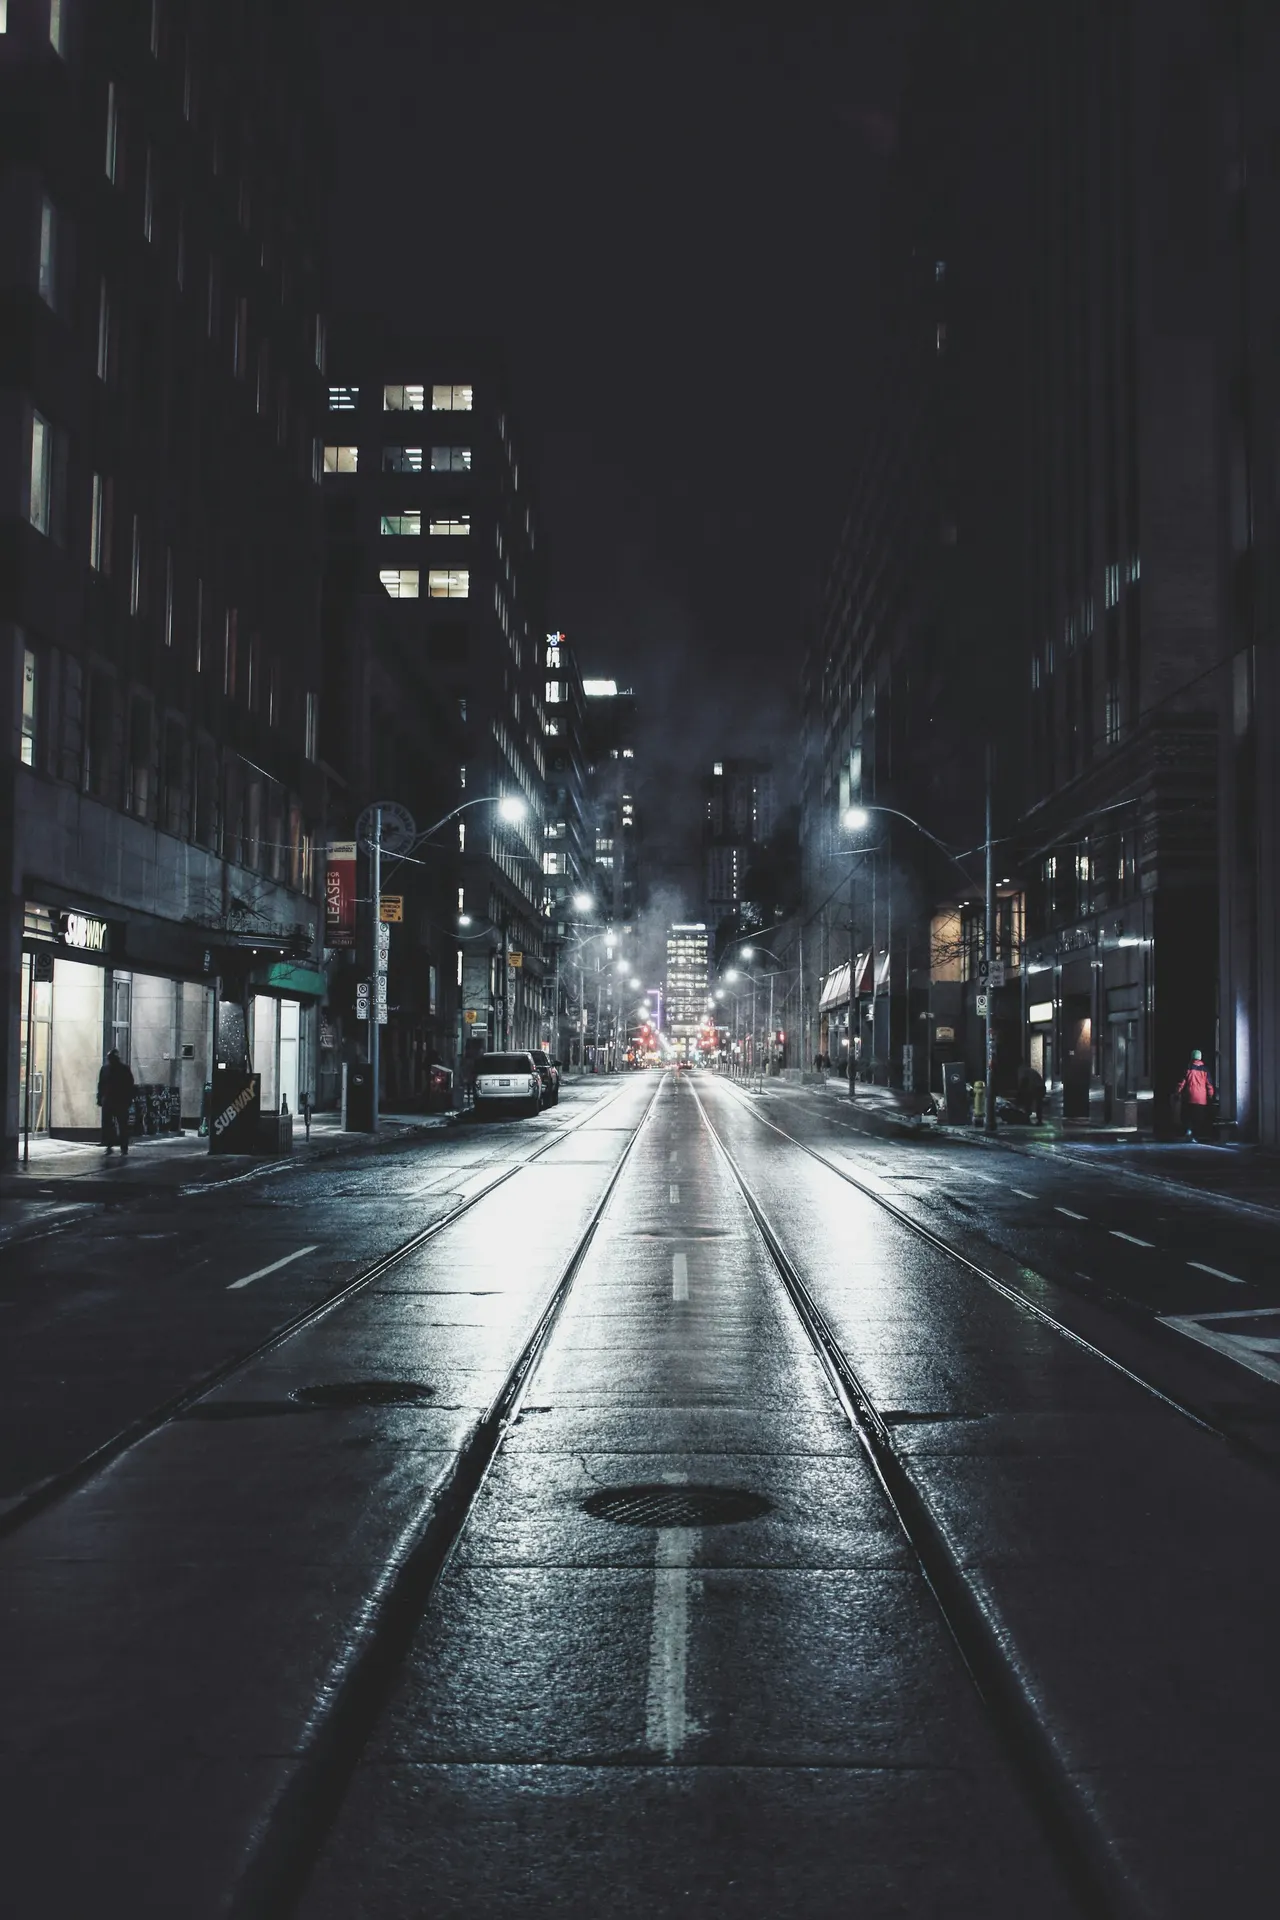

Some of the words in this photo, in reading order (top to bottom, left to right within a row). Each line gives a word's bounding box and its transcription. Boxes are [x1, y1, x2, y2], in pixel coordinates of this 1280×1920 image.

[327, 878, 340, 924] LEASE
[64, 913, 107, 950] SUBWAY
[214, 1080, 256, 1136] SUBWAY
